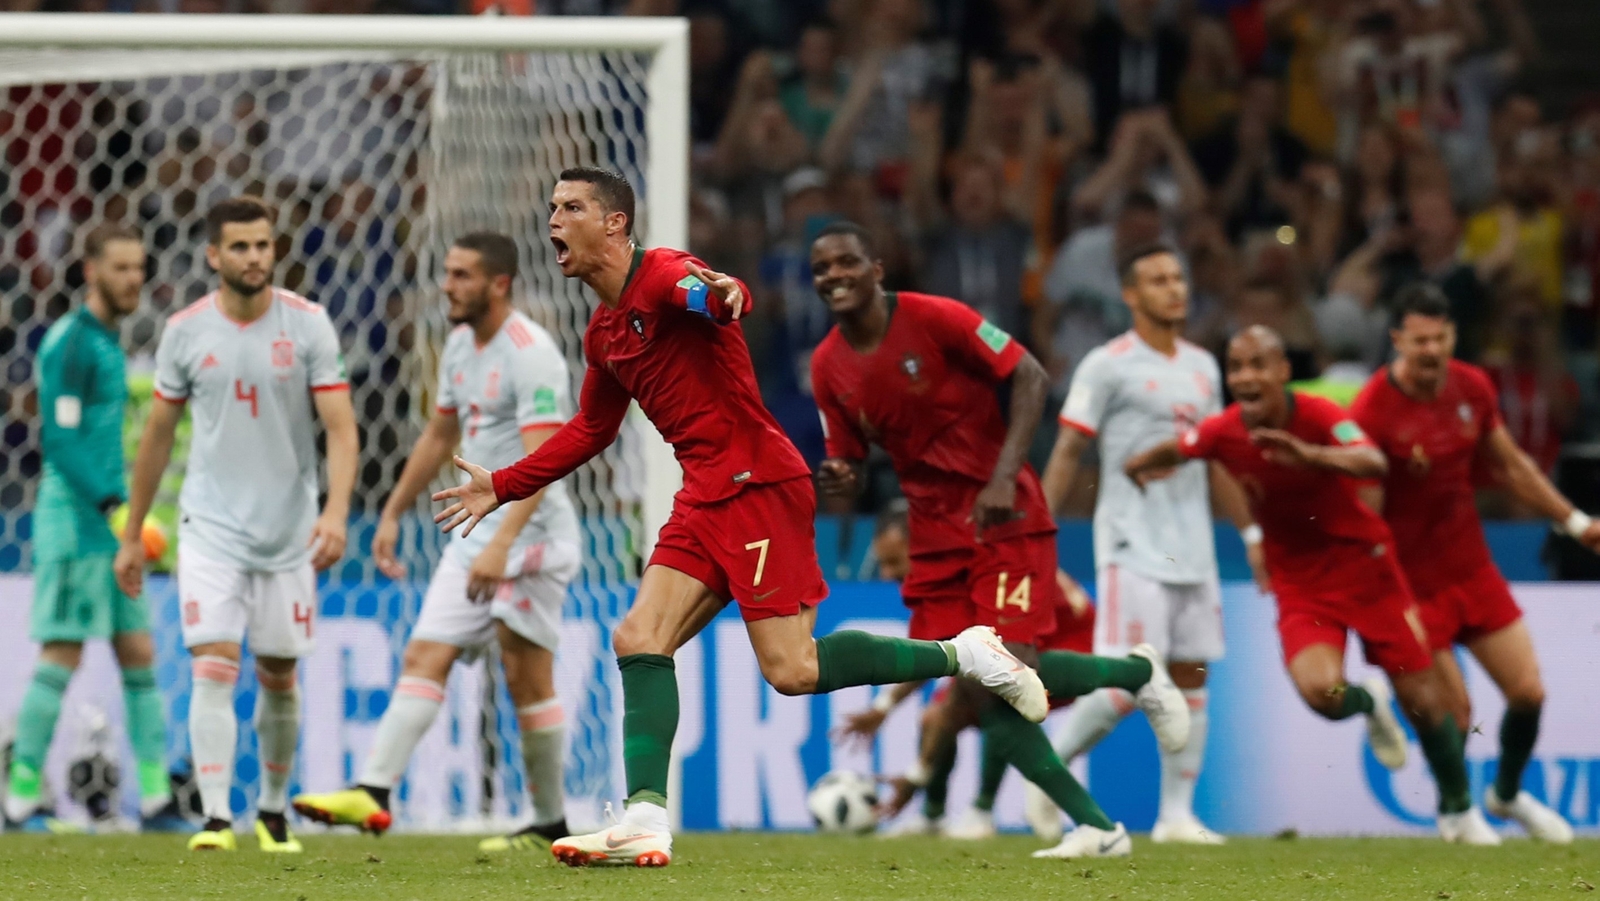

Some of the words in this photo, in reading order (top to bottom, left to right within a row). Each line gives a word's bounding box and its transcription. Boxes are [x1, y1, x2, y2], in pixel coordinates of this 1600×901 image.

[235, 378, 259, 419] 4
[744, 538, 771, 587] 7
[995, 571, 1032, 613] 14
[293, 602, 313, 639] 4
